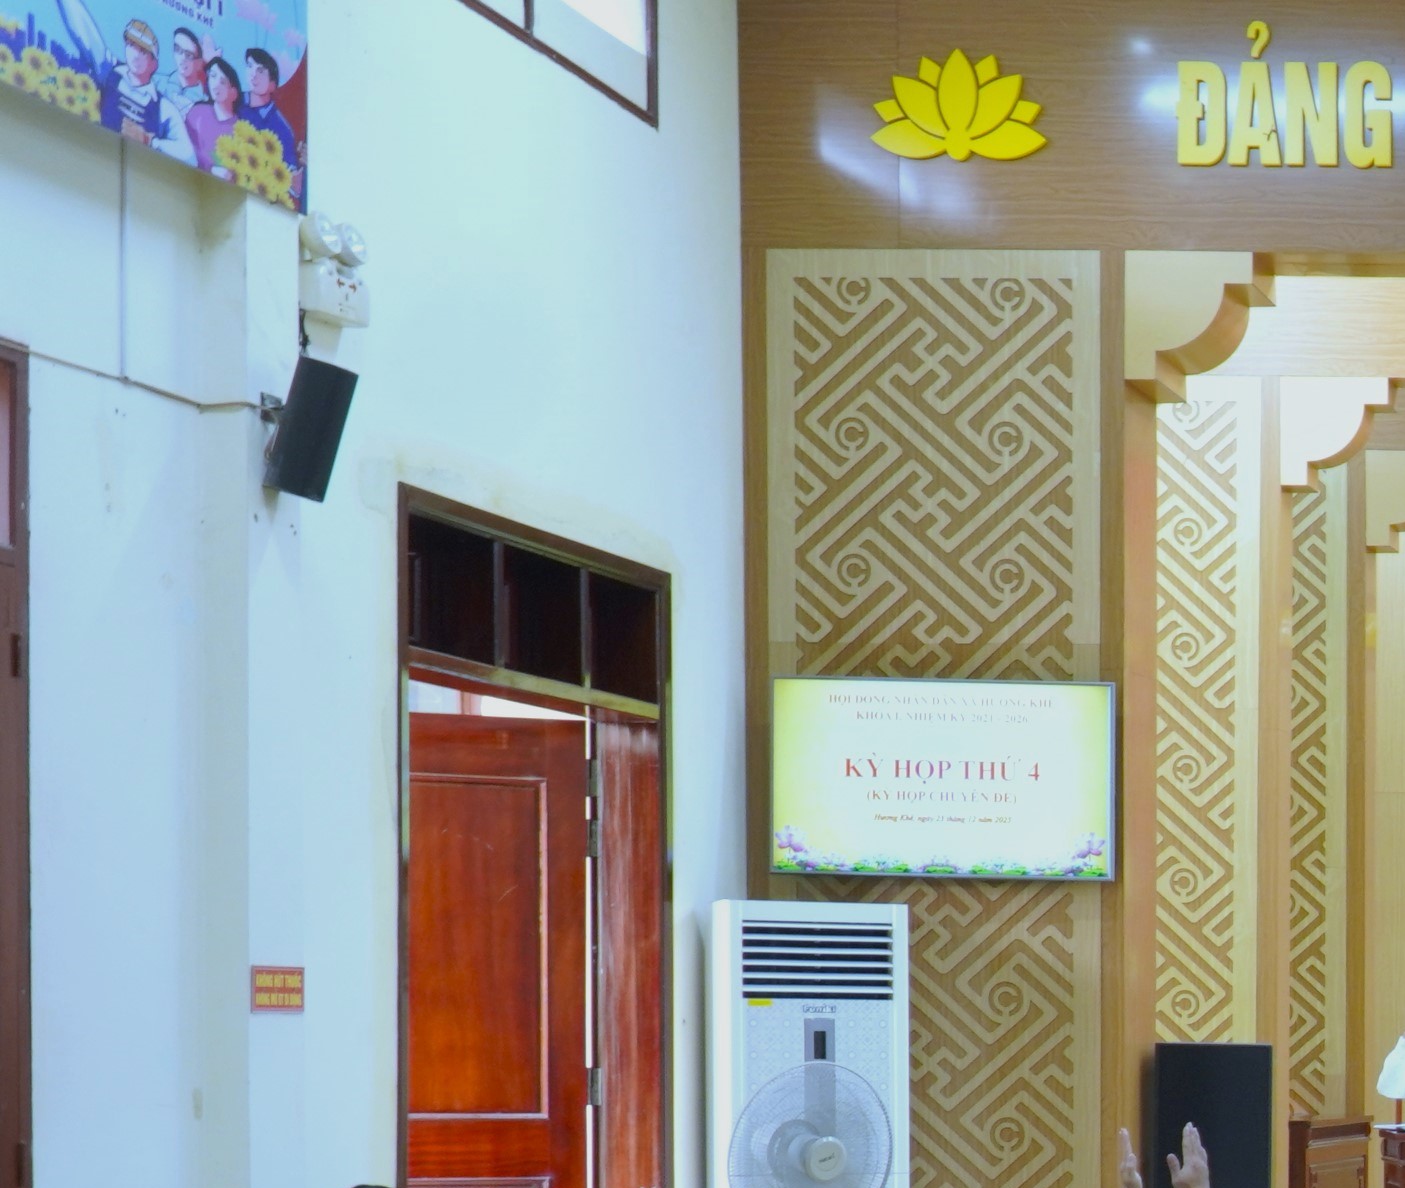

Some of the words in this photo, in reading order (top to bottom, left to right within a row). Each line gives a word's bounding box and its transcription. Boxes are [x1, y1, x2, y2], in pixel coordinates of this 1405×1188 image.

[1176, 20, 1394, 169] ĐẢNG
[844, 752, 885, 779] KỲ
[894, 758, 952, 785] HỌP
[958, 755, 1022, 782] THỨ
[1027, 762, 1041, 782] 4
